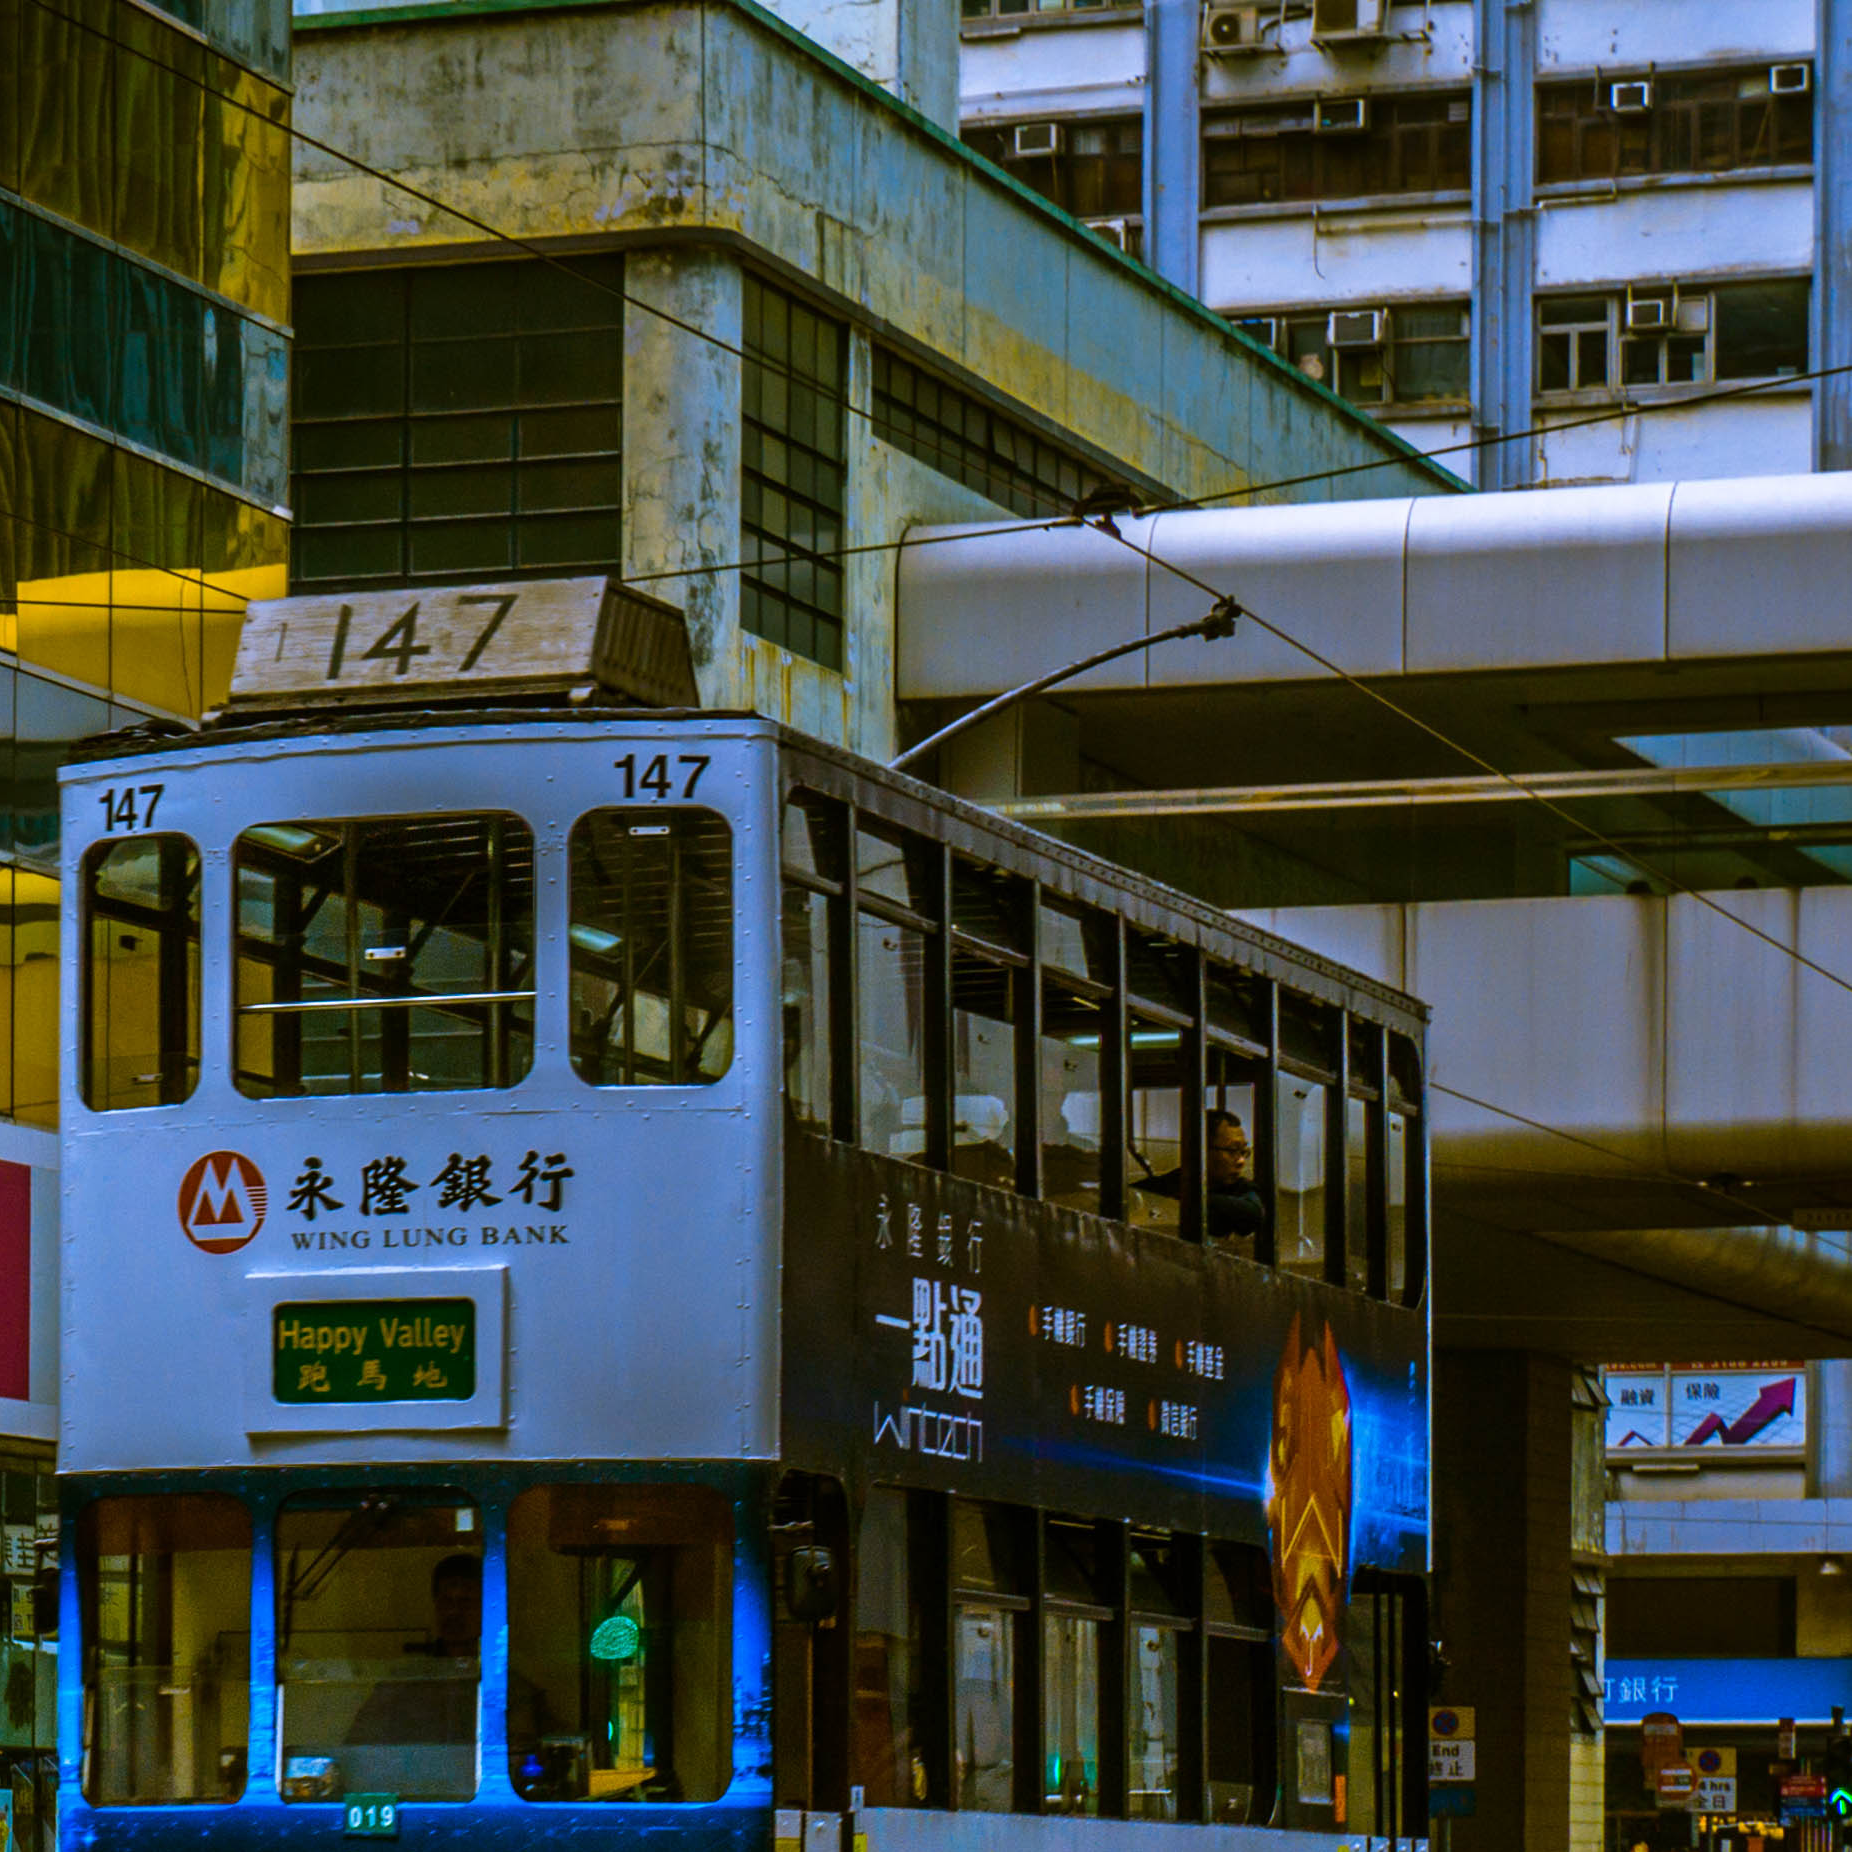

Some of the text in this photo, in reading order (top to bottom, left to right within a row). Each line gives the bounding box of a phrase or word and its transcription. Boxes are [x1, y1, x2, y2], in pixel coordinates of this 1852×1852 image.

[326, 593, 518, 683] 147
[613, 753, 712, 800] 147
[99, 783, 165, 833] 147
[285, 1150, 576, 1222] 永隆銀行
[291, 1224, 572, 1253] WING LUNG BANK
[874, 1193, 984, 1274] 永隆銀行
[278, 1315, 467, 1357] Happy Valley
[873, 1276, 984, 1400] 一點通
[1041, 1305, 1088, 1350] 手機銀行
[296, 1359, 449, 1394] 跑馬地
[1432, 1744, 1460, 1757] End
[348, 1801, 395, 1830] 019
